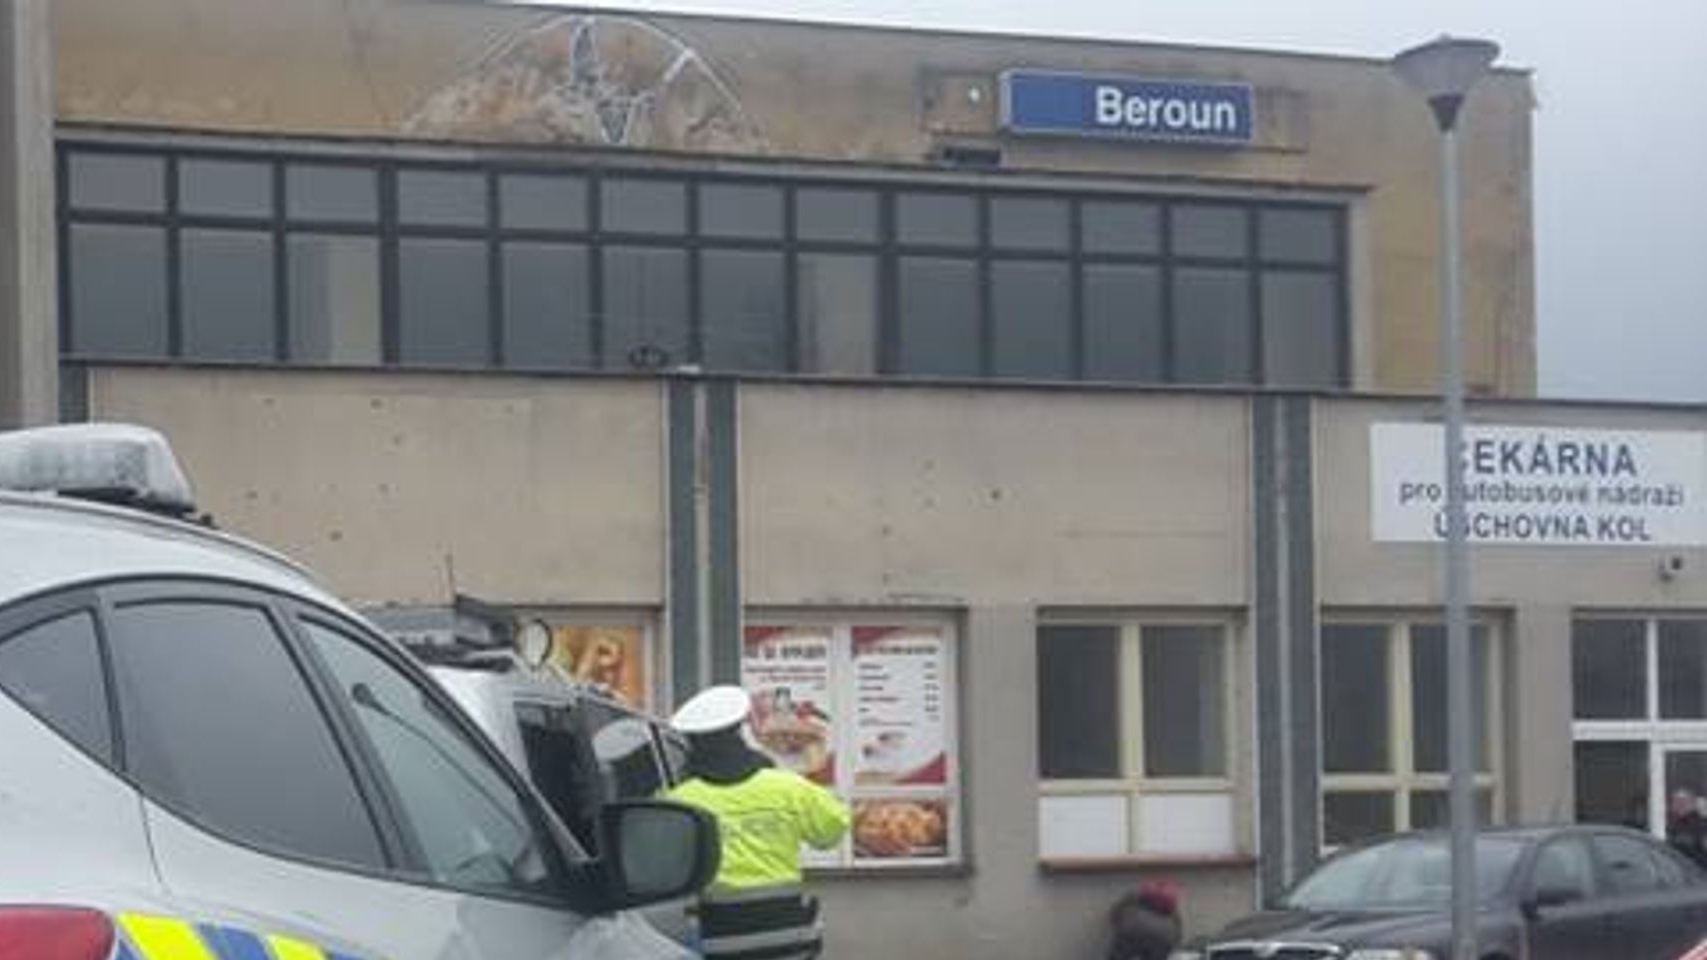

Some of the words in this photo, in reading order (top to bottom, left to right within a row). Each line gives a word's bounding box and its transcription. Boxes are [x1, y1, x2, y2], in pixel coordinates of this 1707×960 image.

[1096, 86, 1236, 130] Beroun
[1400, 482, 1441, 506] pro
[1458, 480, 1590, 505] utobusové
[1597, 513, 1652, 542] KOL
